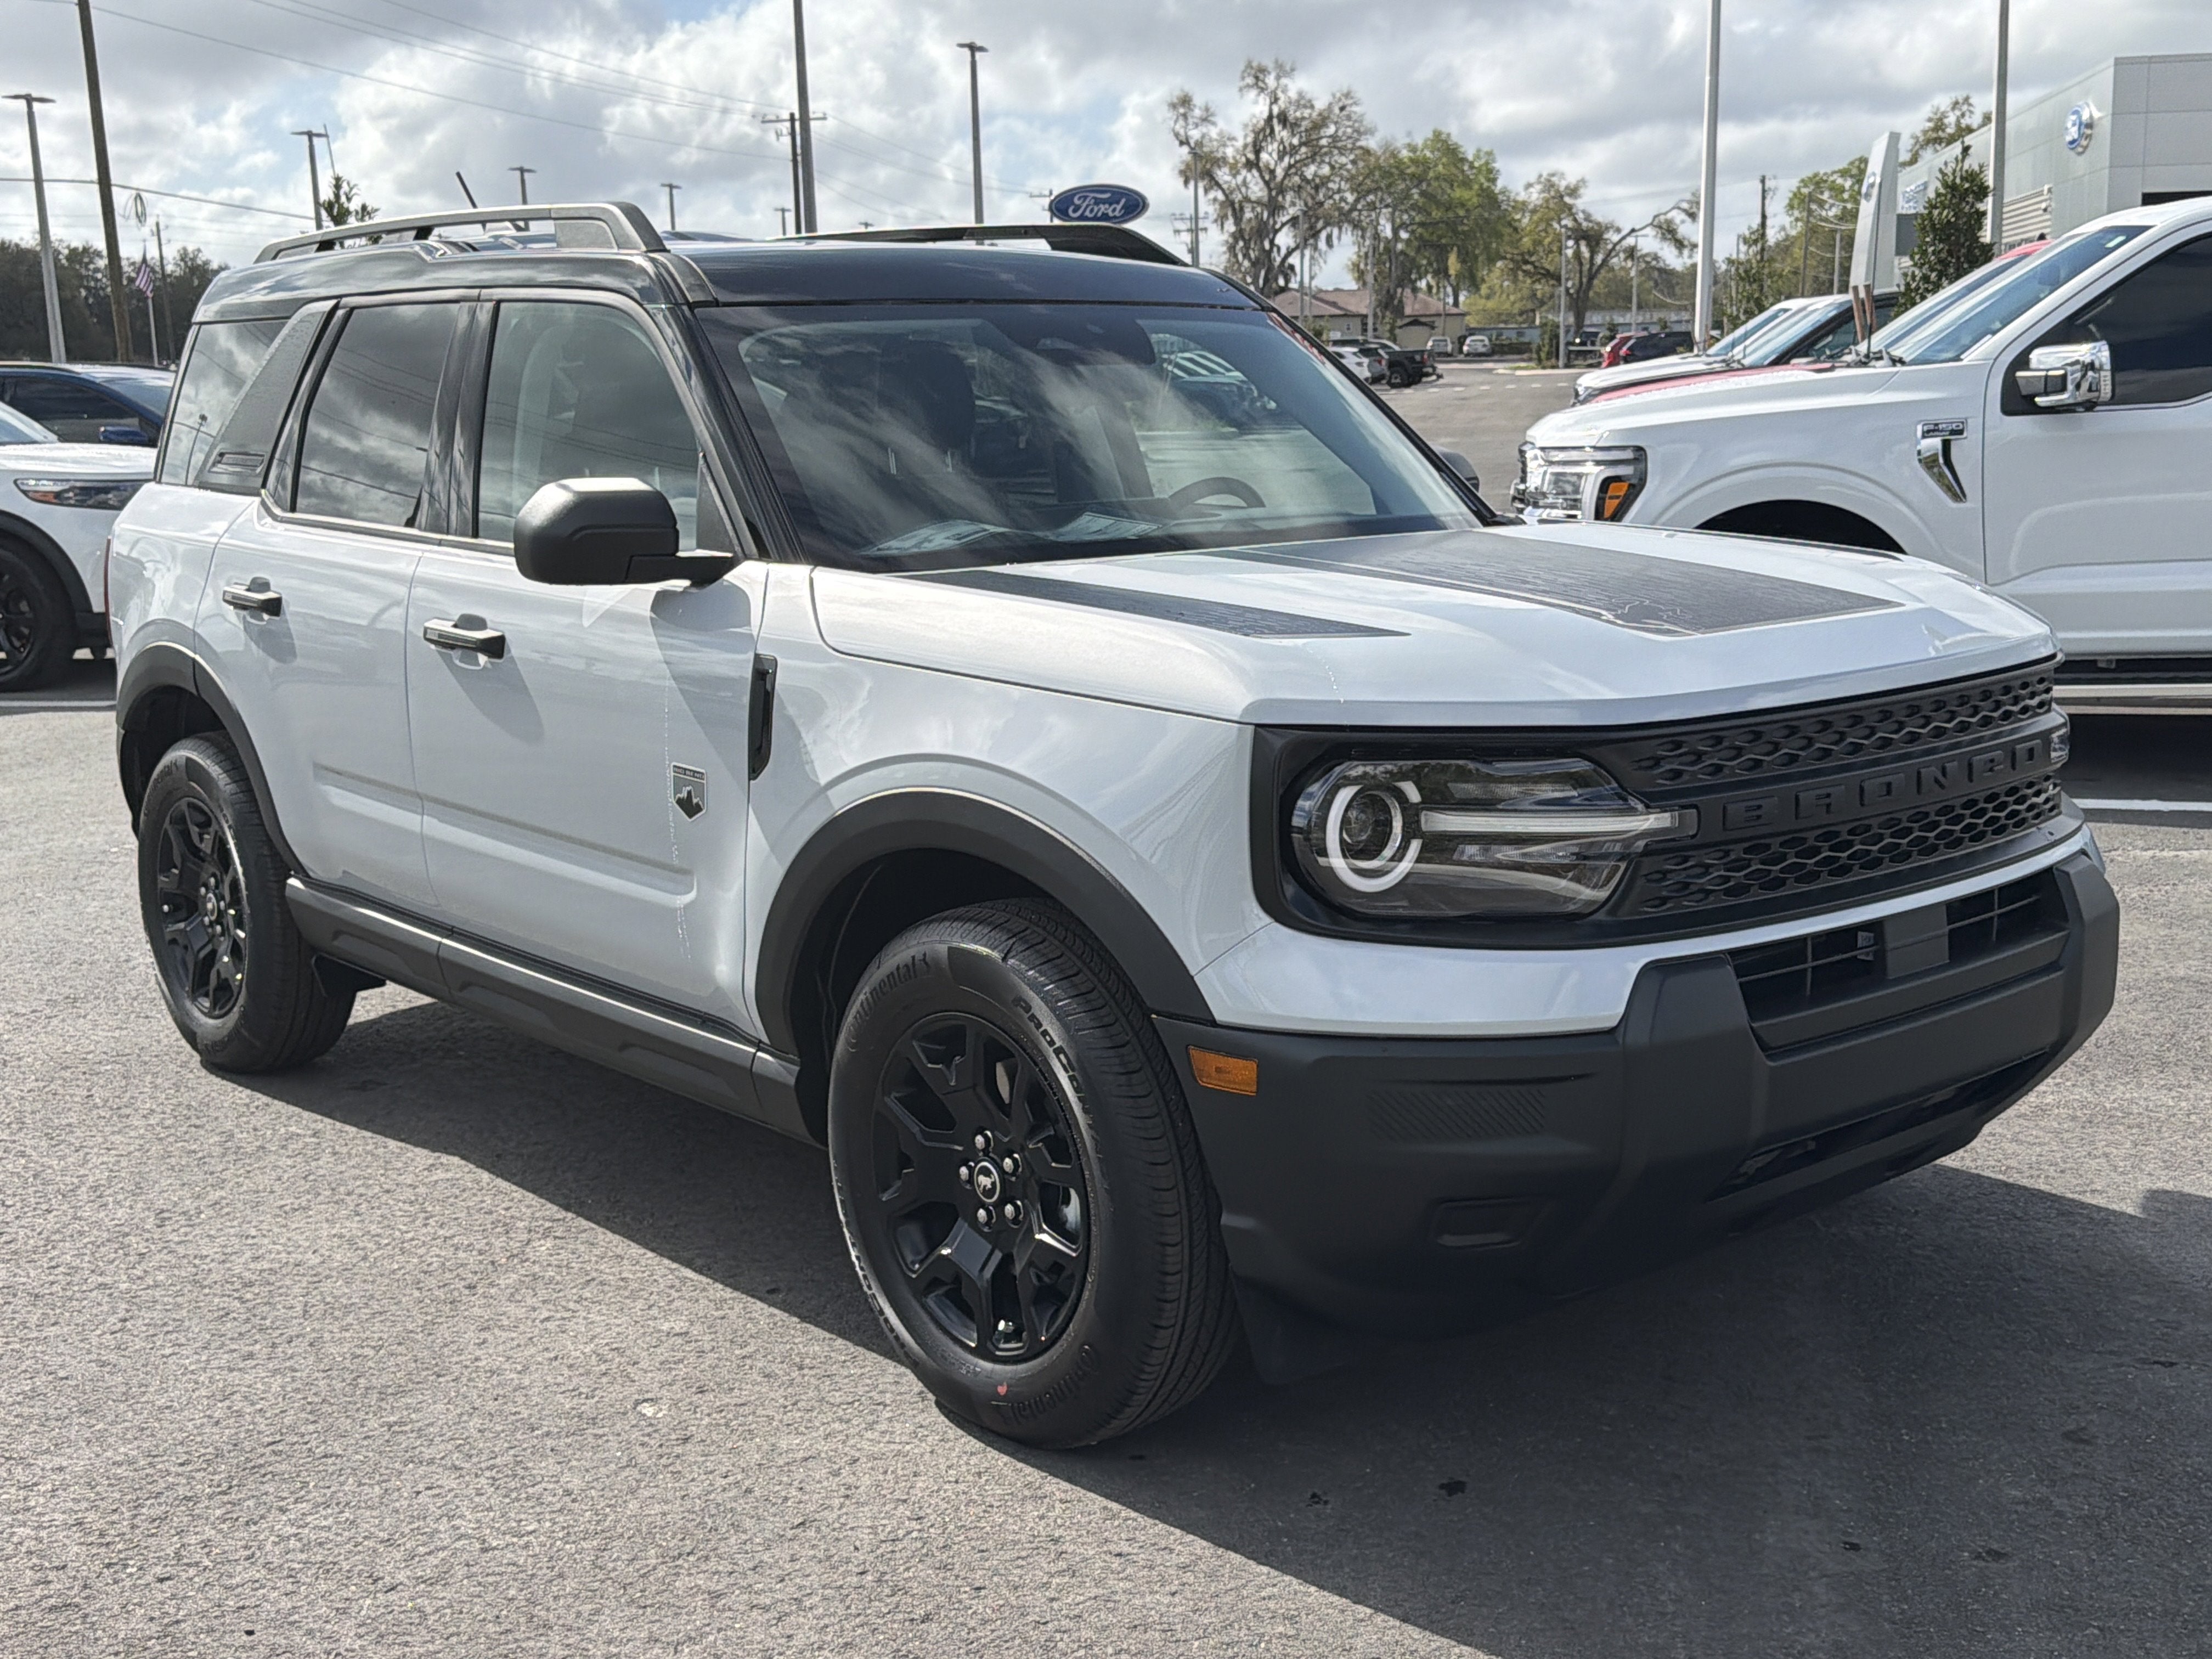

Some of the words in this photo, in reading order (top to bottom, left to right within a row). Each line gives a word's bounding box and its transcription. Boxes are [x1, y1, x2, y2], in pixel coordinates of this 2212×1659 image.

[1068, 192, 1126, 218] Ford
[1923, 423, 1963, 431] F-150
[1724, 740, 2042, 830] BRONCO
